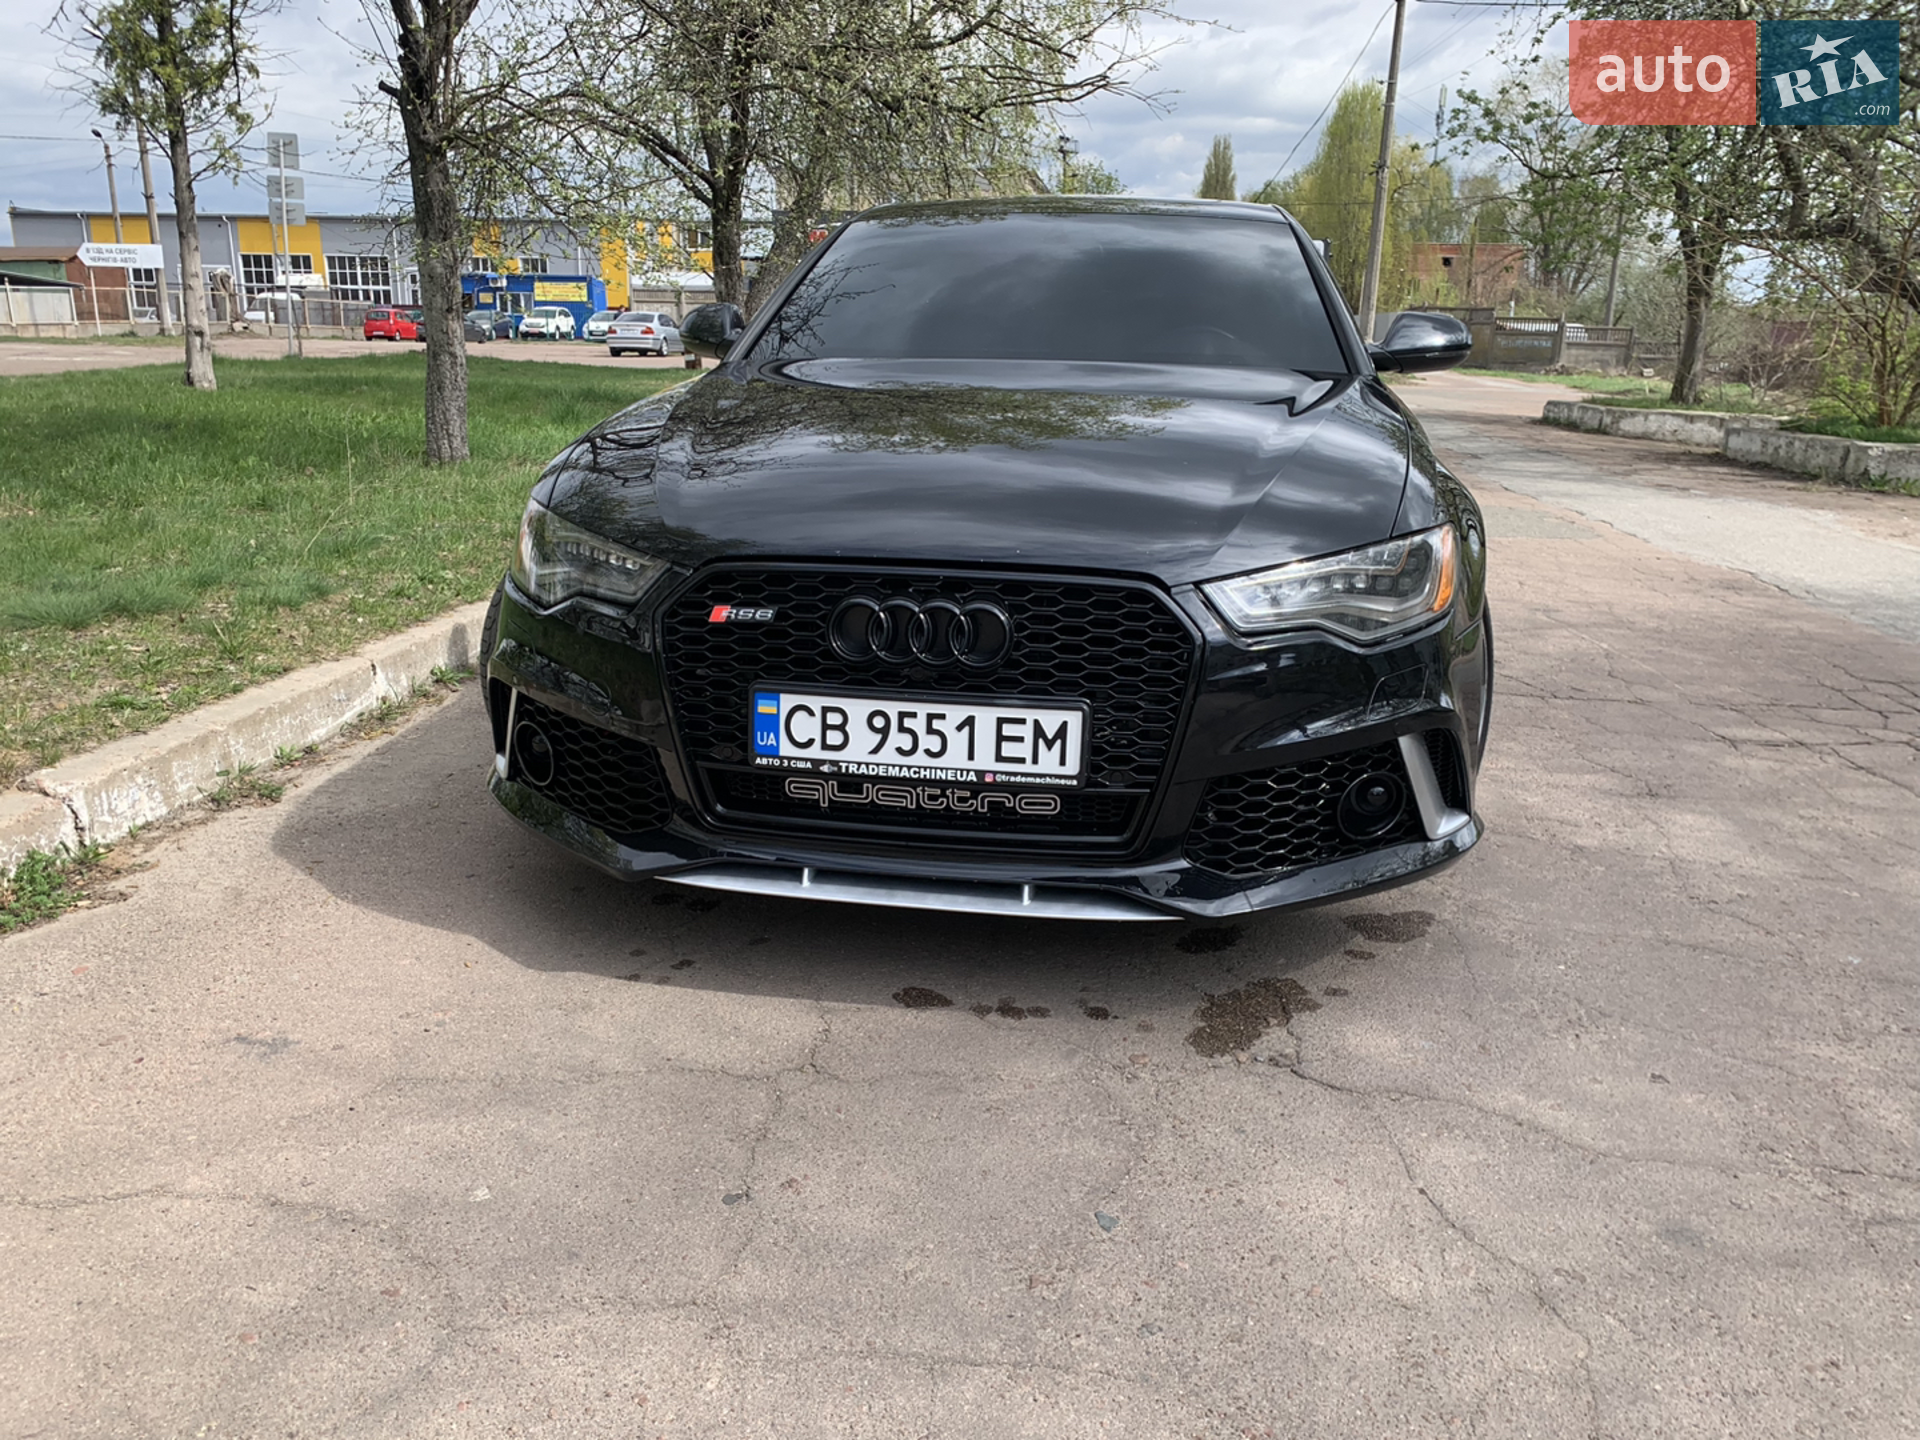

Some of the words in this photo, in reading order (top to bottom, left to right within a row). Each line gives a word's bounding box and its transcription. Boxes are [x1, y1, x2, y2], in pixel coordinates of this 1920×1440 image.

[114, 247, 138, 256] СЕРВІС
[717, 607, 773, 620] RS6
[757, 731, 777, 748] UA
[784, 704, 850, 752] CB
[865, 709, 976, 762] 9551
[994, 716, 1068, 767] EM
[755, 757, 780, 767] АВТО
[790, 761, 813, 769] США
[839, 762, 978, 783] TRADEMACHINEUA
[995, 774, 1078, 787] @trademachineua
[785, 777, 1060, 815] quattro
